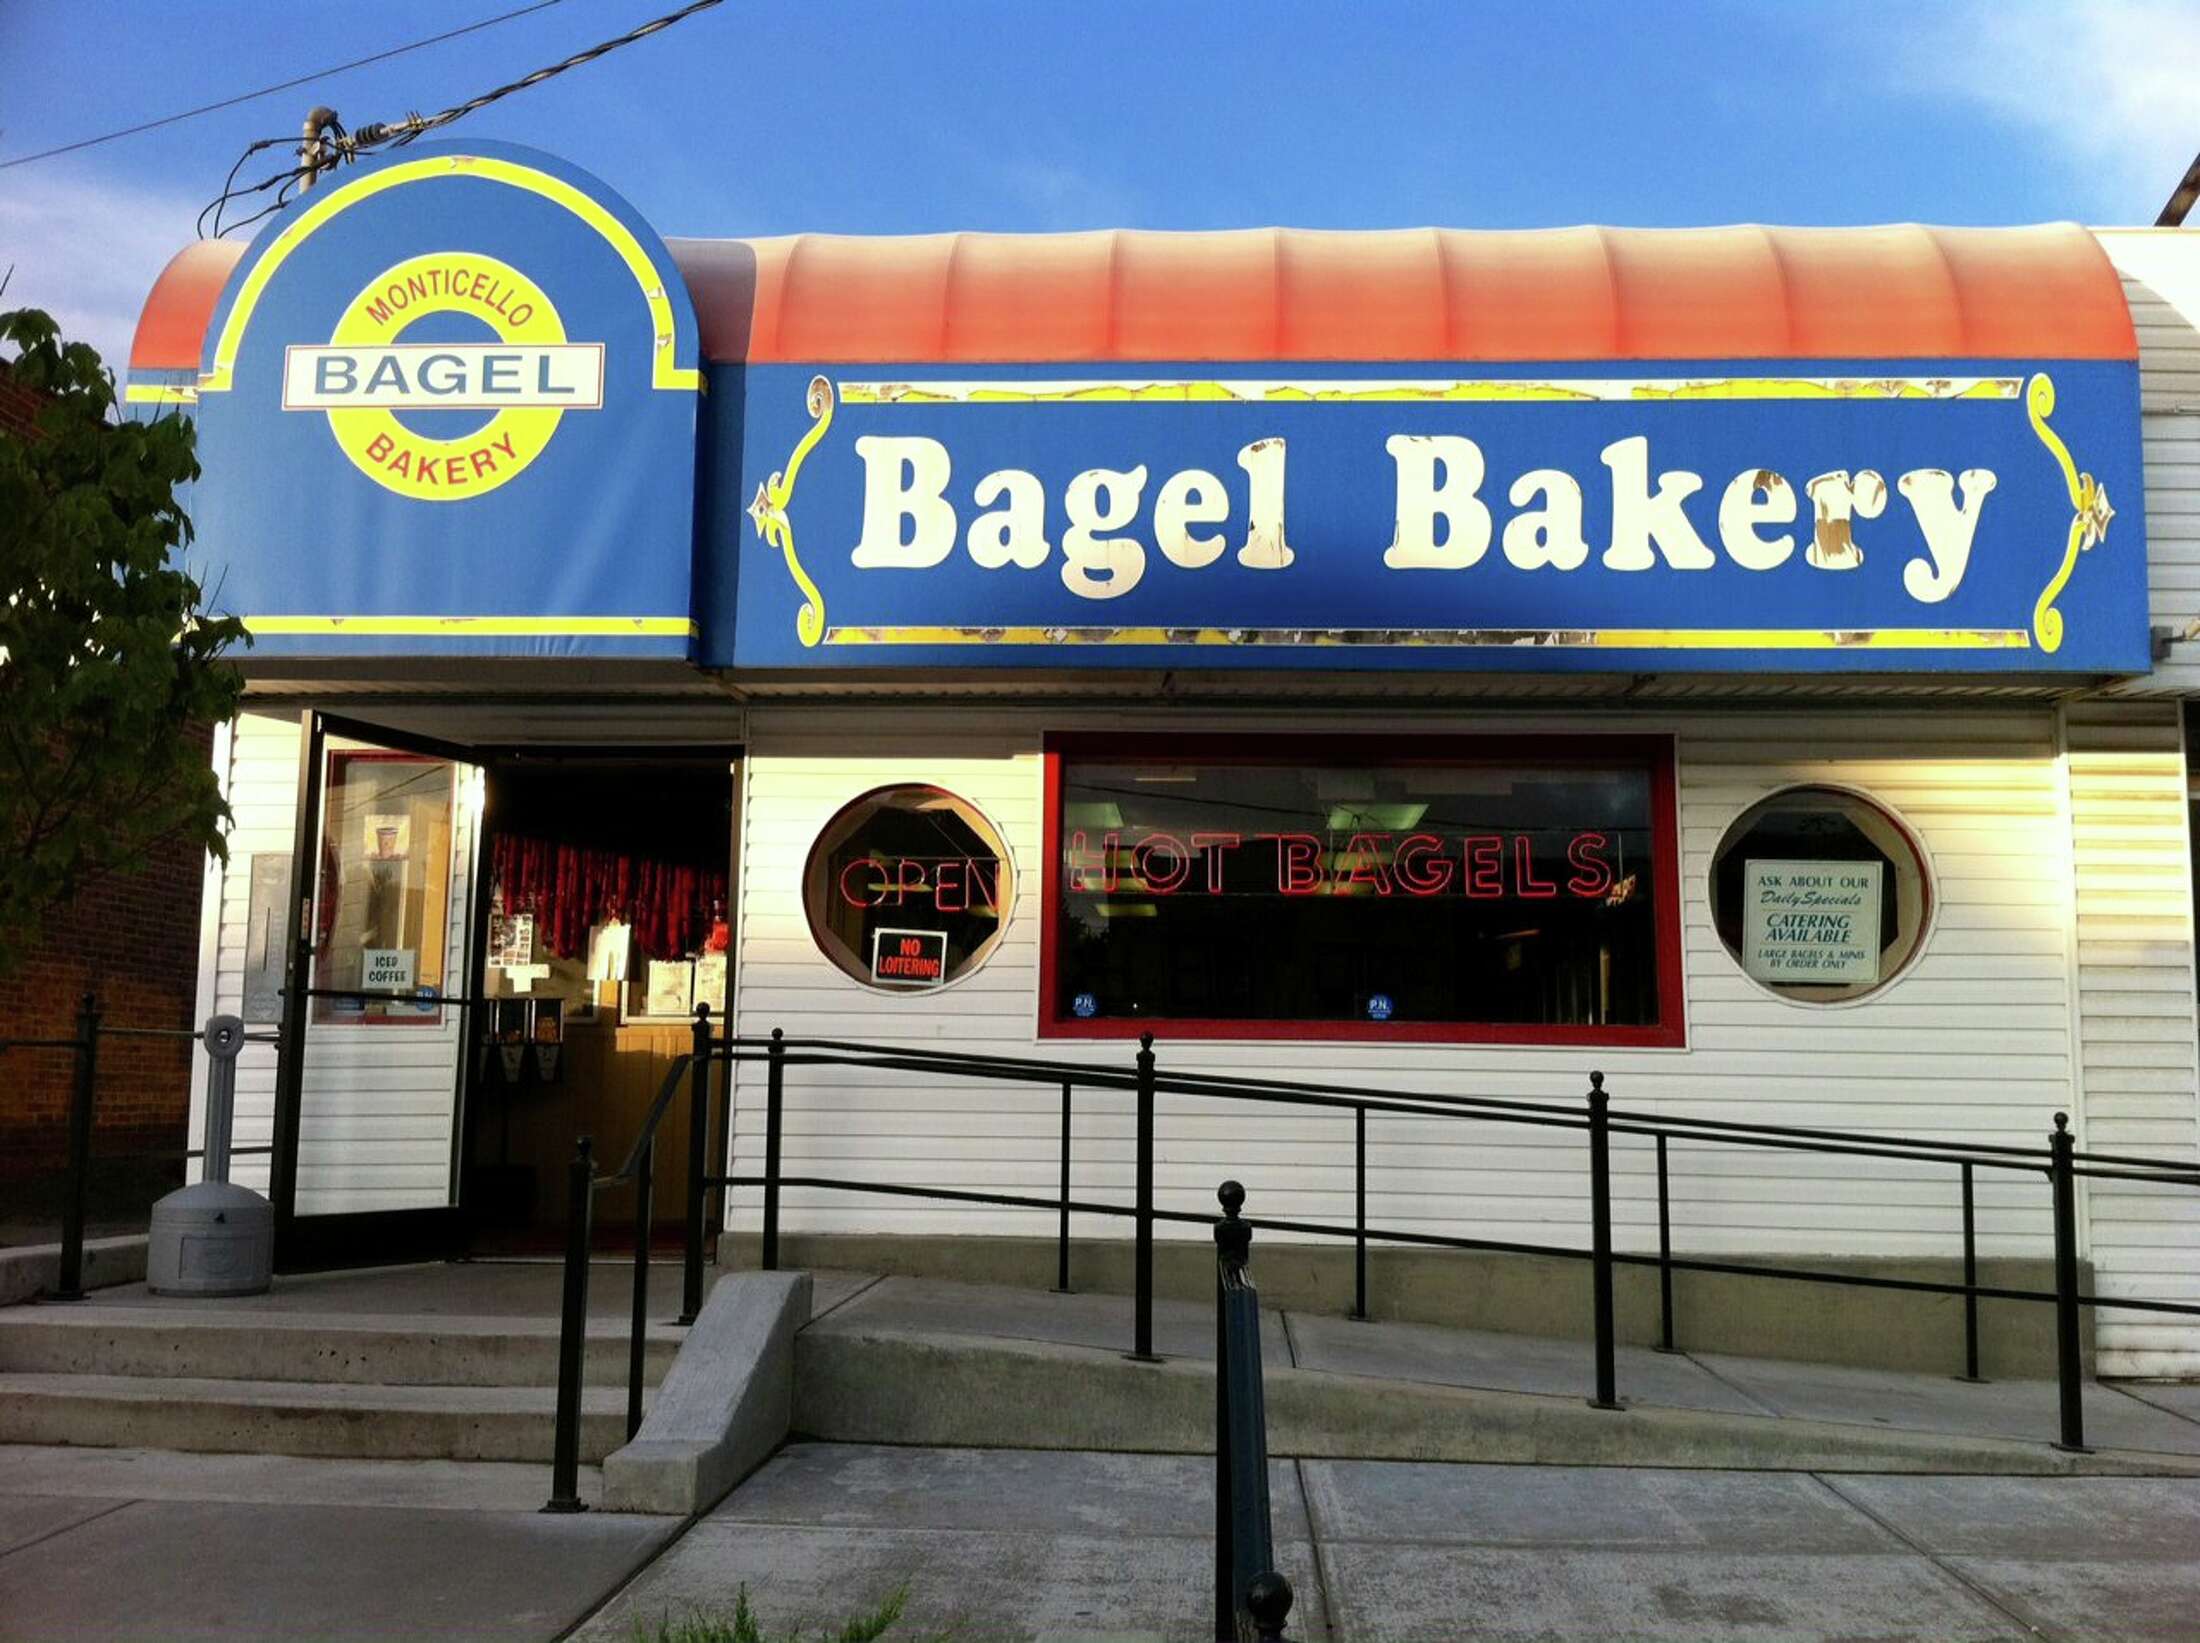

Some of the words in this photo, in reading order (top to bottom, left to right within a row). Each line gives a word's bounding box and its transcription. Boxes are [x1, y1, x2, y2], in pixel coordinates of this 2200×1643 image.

[366, 269, 533, 327] MONTICELLO
[314, 353, 575, 396] BAGEL
[366, 432, 518, 485] BAKERY
[851, 435, 1295, 599] Bagel
[1383, 435, 1997, 603] Bakery
[1070, 832, 1239, 893] HOT
[1276, 831, 1614, 897] BAGELS
[840, 858, 1000, 911] OPEN
[1758, 876, 1782, 887] ASK
[1789, 876, 1834, 888] ABOUT
[1840, 877, 1869, 888] OUR
[1760, 890, 1799, 907] Daily
[1800, 891, 1862, 908] Specials
[1766, 913, 1852, 929] CATERING
[1765, 928, 1852, 943] AVAILABLE
[900, 938, 921, 956] NO
[1758, 949, 1787, 959] LARGE
[1791, 950, 1823, 959] BAGELS
[375, 956, 399, 967] ICED
[878, 955, 940, 977] LOITERING
[1770, 959, 1781, 968] BY
[1786, 960, 1819, 969] ORDER
[1822, 960, 1846, 969] ONLY
[368, 970, 407, 982] COFFEE
